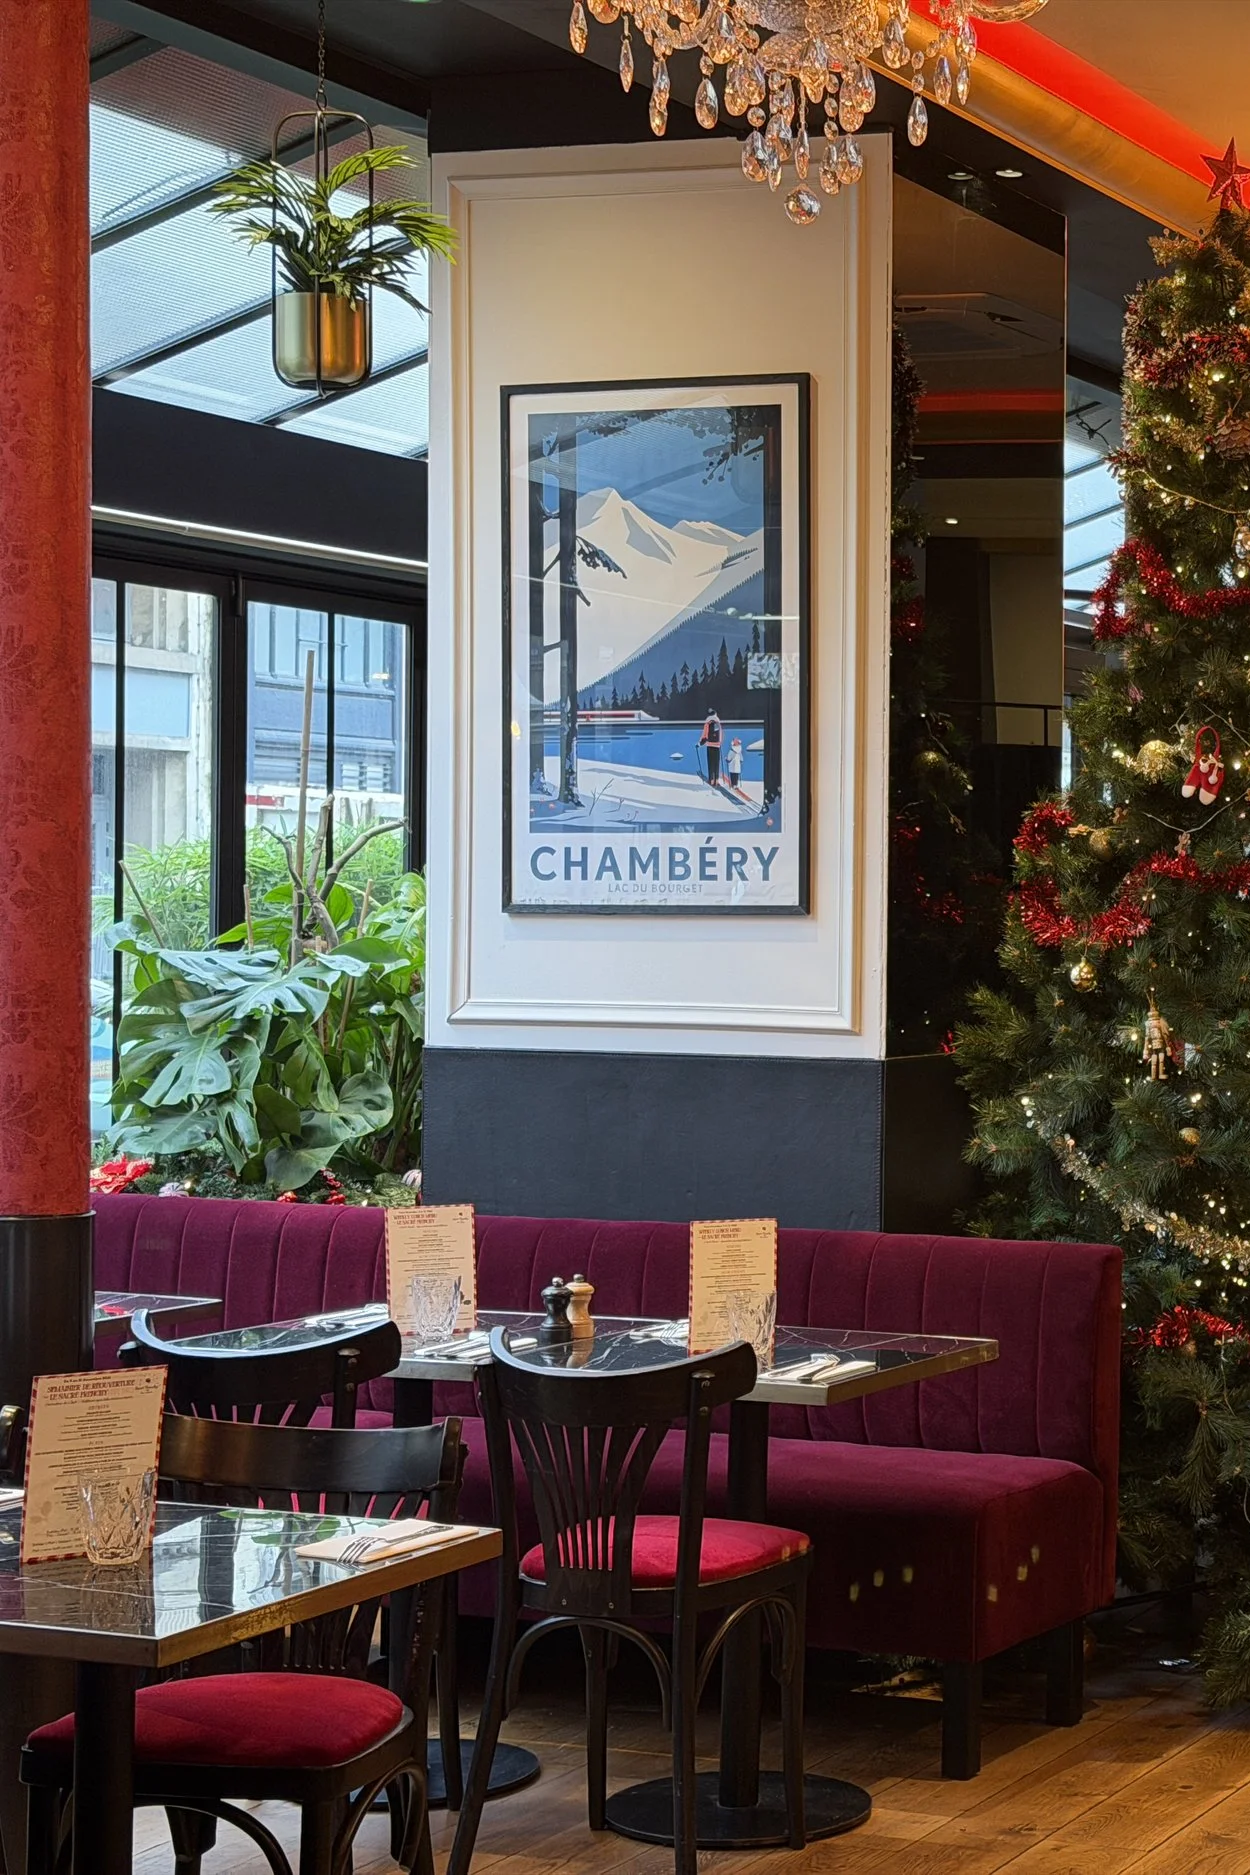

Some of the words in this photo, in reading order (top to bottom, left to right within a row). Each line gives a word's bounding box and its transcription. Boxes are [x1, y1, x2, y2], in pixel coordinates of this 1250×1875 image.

[530, 836, 780, 882] CHAMBÉRY
[608, 883, 629, 893] LAC
[632, 883, 648, 893] DU
[651, 883, 704, 894] BOURGET
